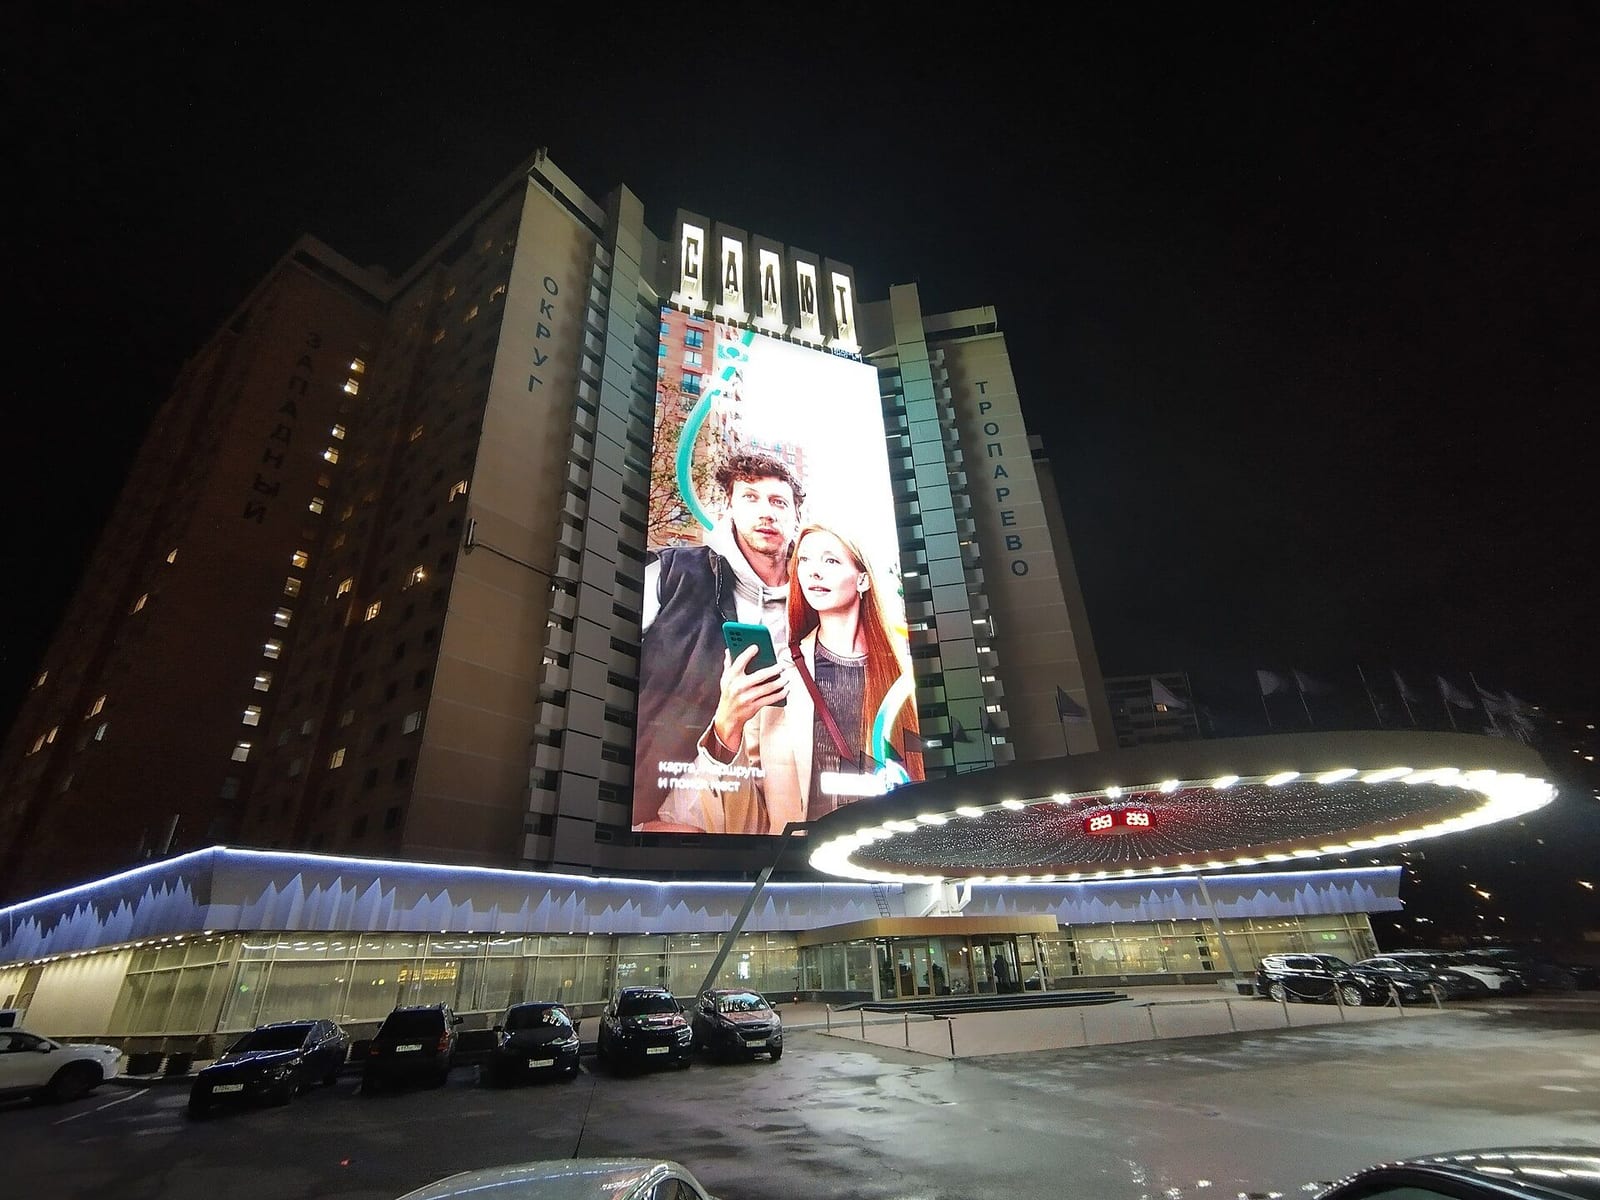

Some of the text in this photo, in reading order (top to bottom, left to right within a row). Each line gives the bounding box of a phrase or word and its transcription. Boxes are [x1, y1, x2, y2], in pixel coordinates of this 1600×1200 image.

[528, 276, 559, 392] ОКРУГ
[684, 235, 848, 327] САЛЮТ
[243, 333, 322, 524] ЗАПАДНЫЙ
[975, 380, 1029, 577] ТРОПАРЕВО
